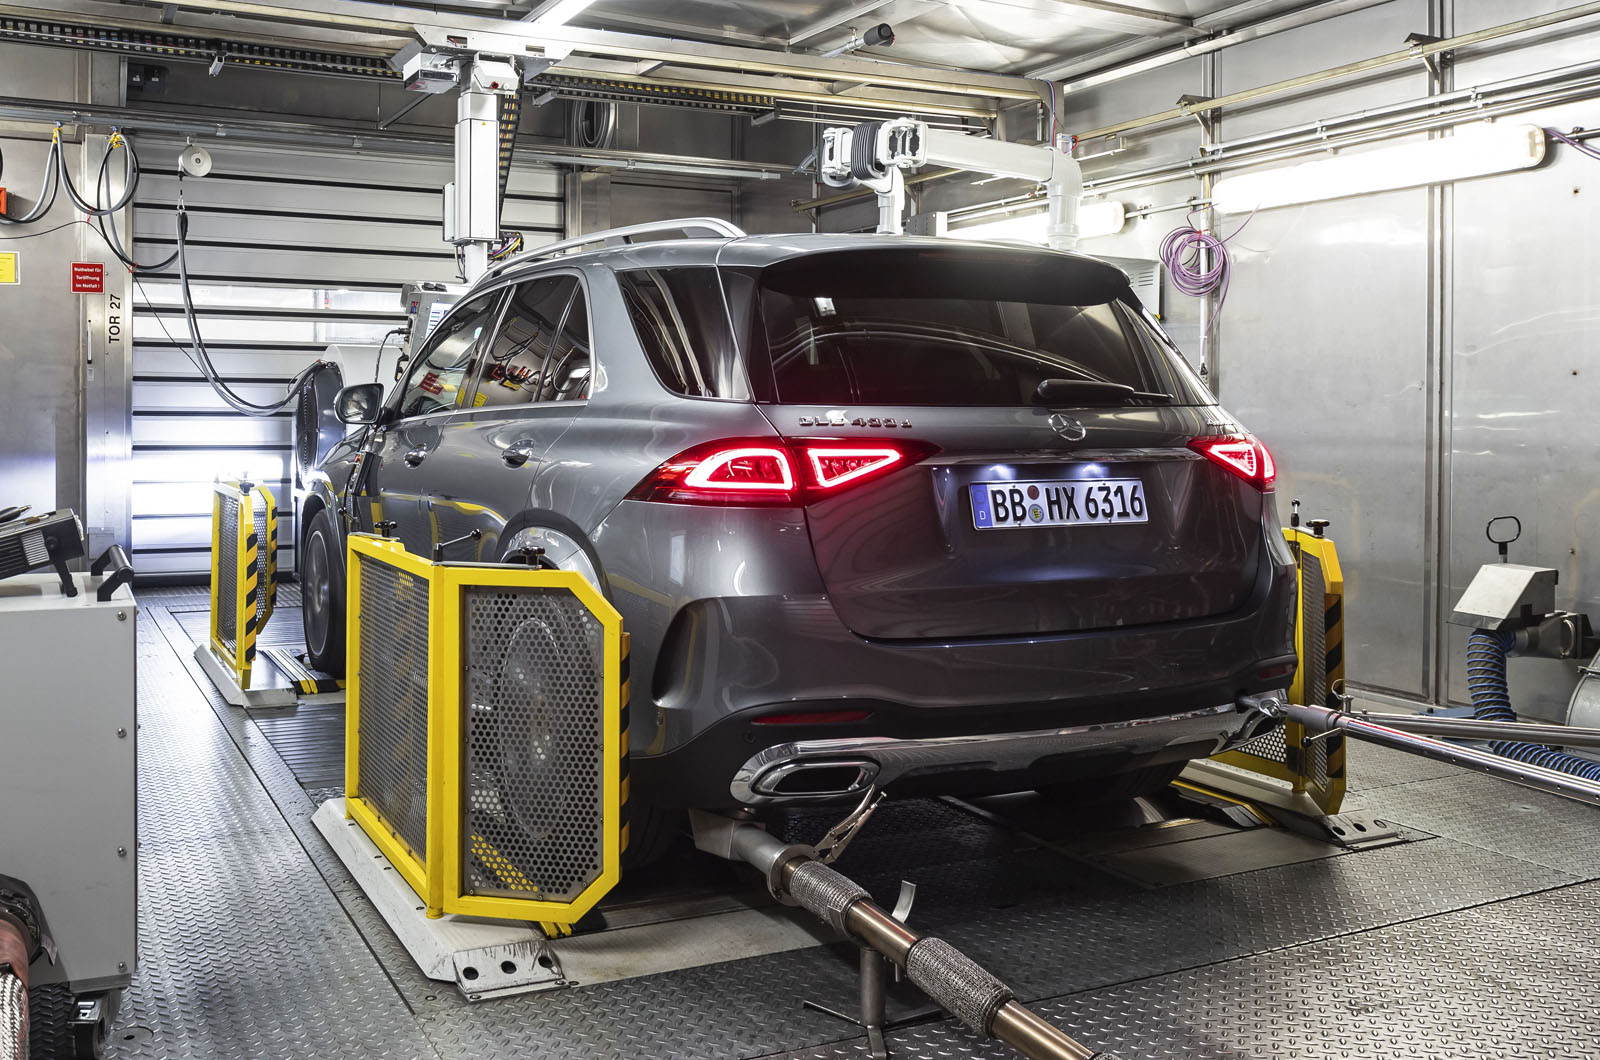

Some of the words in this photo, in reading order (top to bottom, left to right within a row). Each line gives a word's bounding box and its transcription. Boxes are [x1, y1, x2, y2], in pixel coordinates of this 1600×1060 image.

[110, 294, 120, 309] 27
[109, 316, 120, 344] TOR
[991, 488, 1027, 522] BB
[1045, 486, 1080, 521] HX
[1085, 485, 1144, 519] 6316
[979, 510, 986, 521] D
